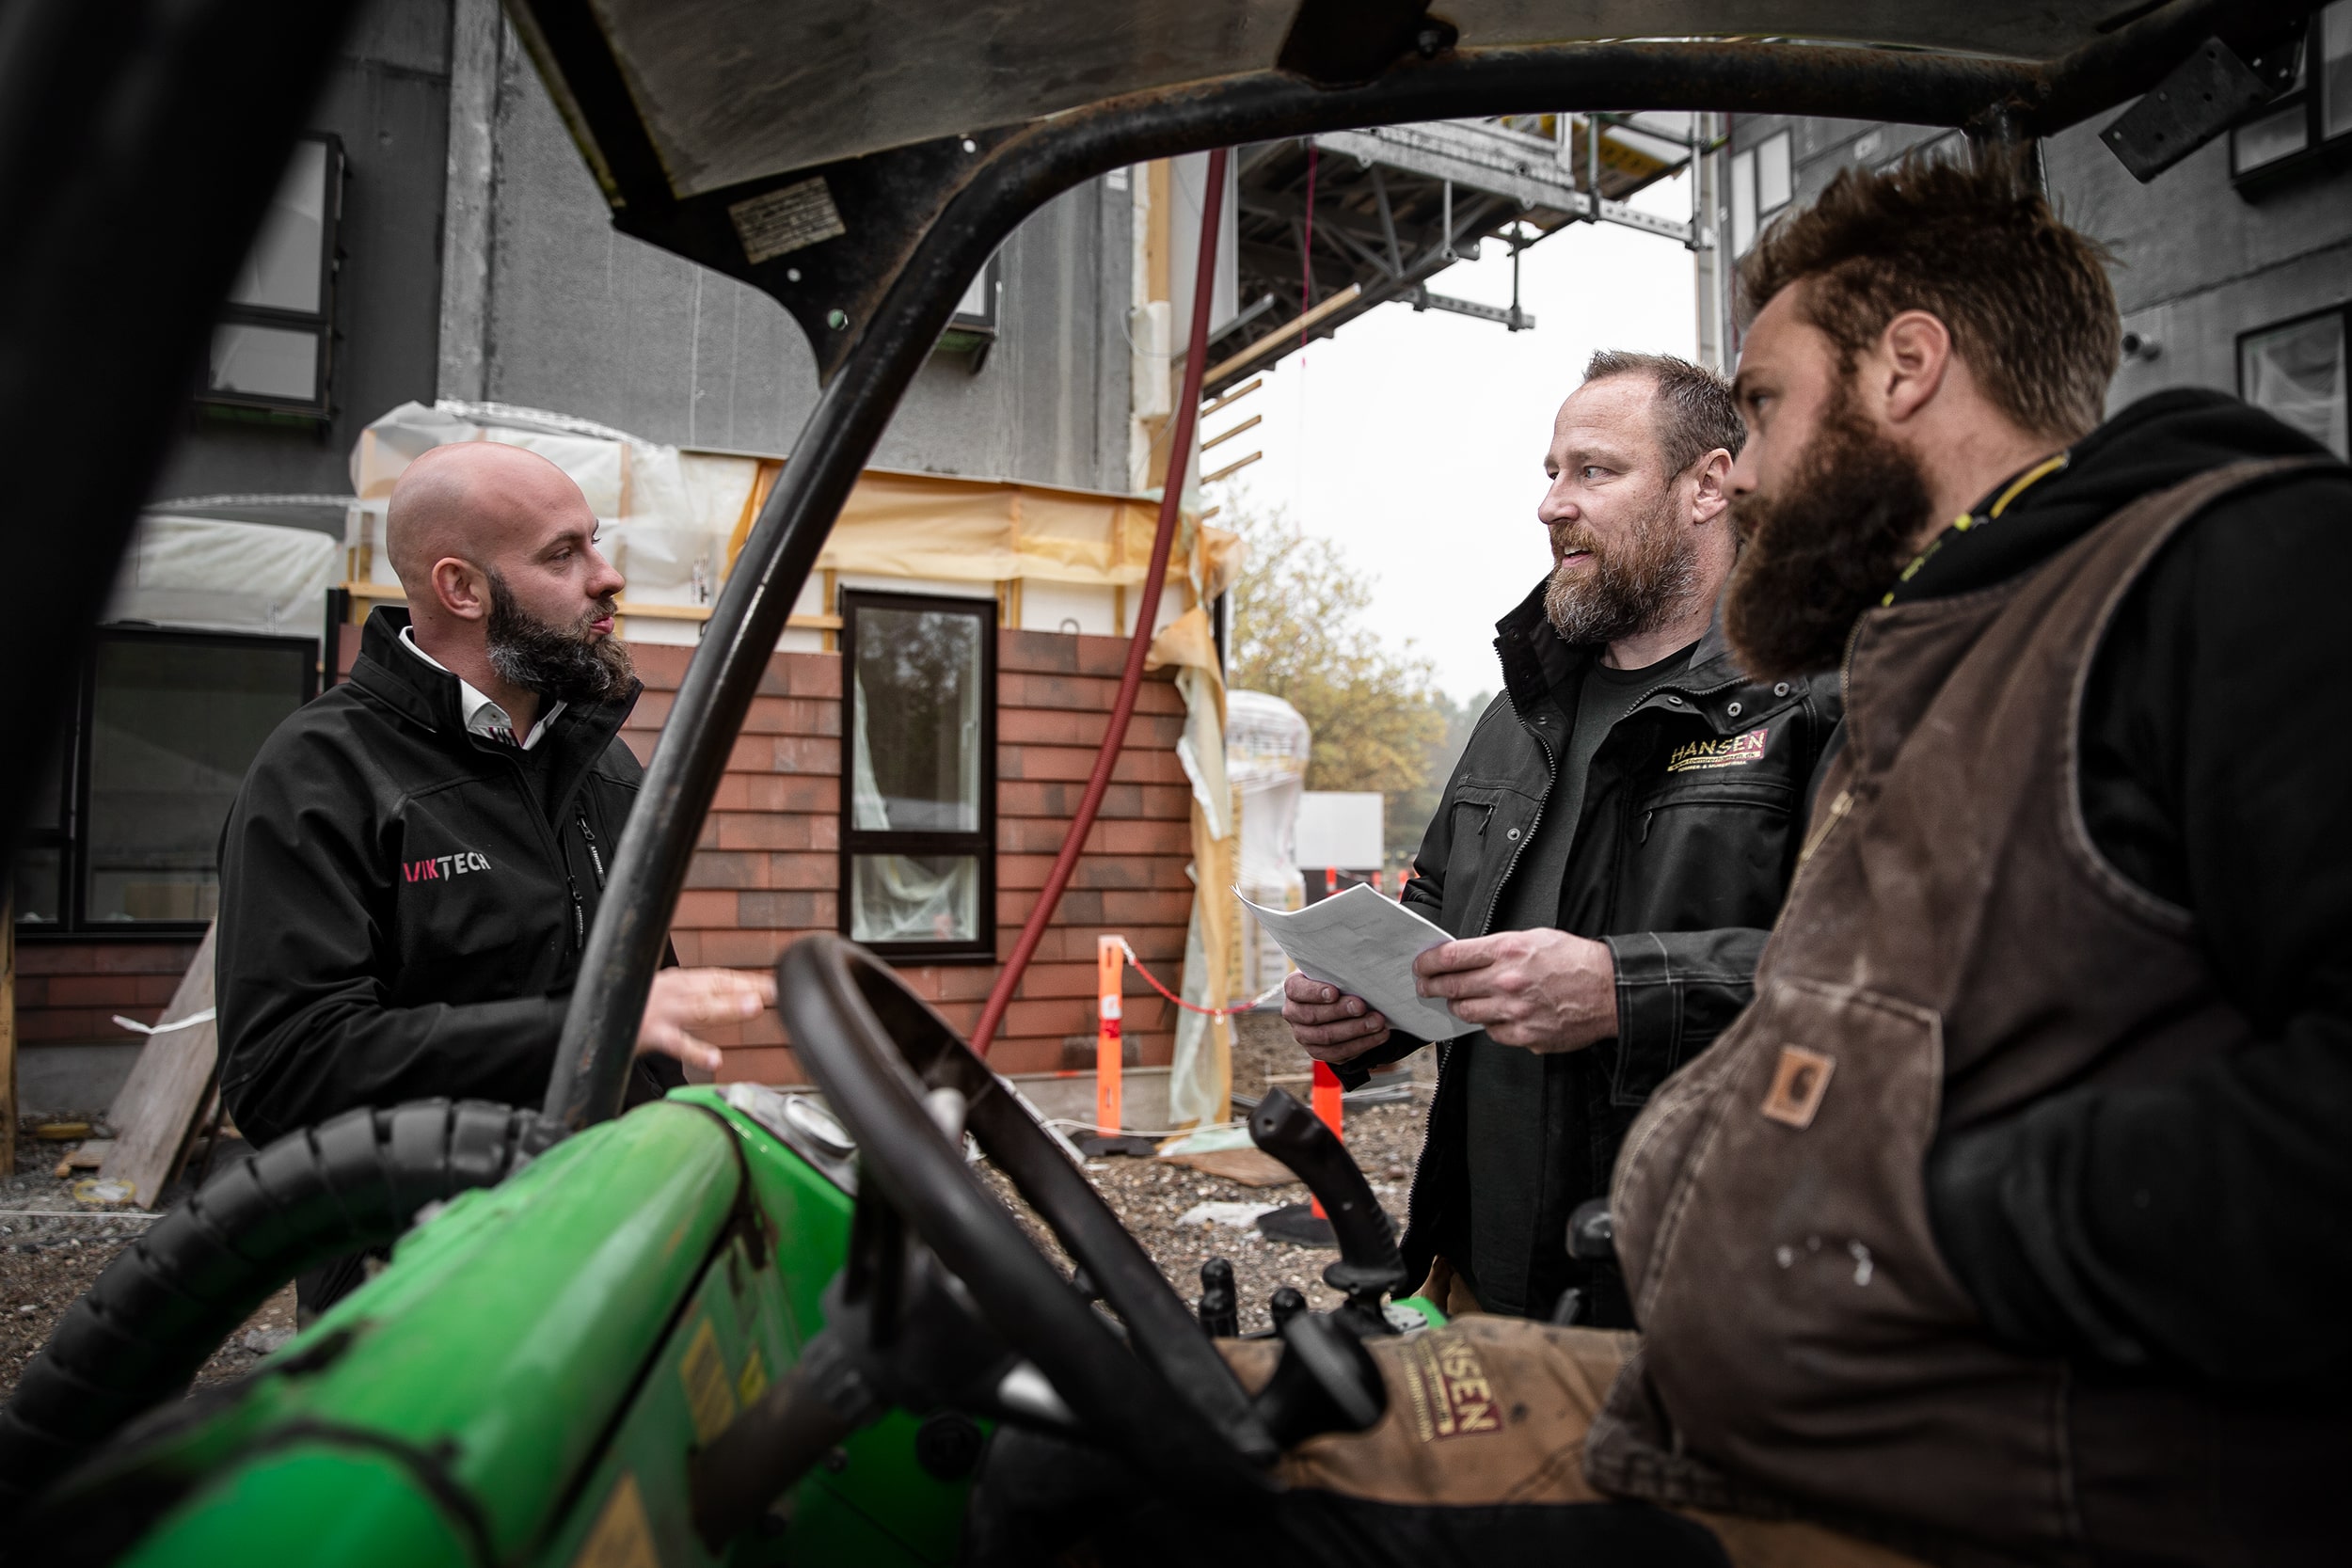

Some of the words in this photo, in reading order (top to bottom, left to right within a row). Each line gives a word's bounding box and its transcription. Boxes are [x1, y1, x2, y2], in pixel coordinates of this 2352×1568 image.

[1671, 732, 1765, 764] HANSEN
[403, 851, 492, 882] VIKTECH
[1439, 1336, 1498, 1432] NSEN
